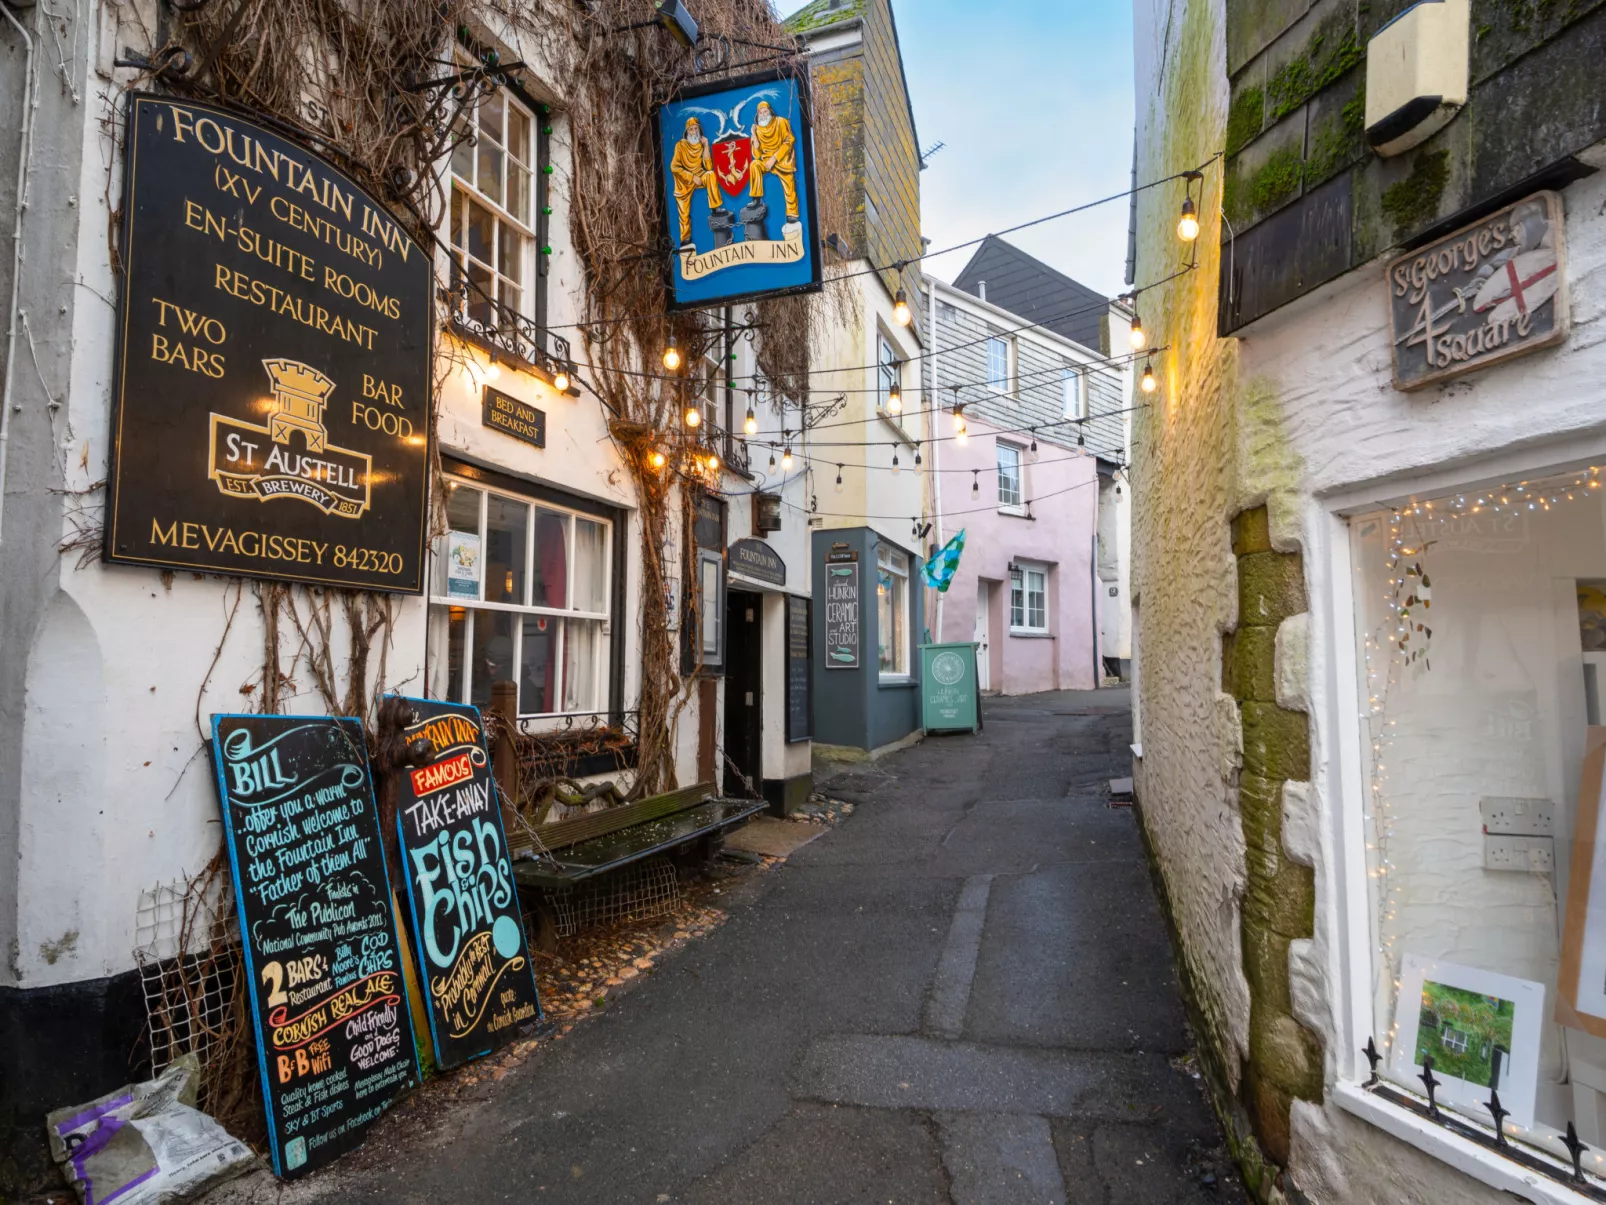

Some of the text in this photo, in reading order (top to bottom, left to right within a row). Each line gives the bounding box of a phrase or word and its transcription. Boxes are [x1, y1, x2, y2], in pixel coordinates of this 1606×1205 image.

[170, 105, 412, 263] FOUNTAIN INN
[214, 164, 383, 270] (XV CENTURY)
[185, 200, 401, 320] EN-SUITE ROOMS
[685, 242, 799, 276] FOUNTAIN INN
[152, 298, 226, 344] TWO
[214, 263, 379, 351] RESTAURANT
[1407, 291, 1455, 366] 4
[151, 334, 226, 379] BARS
[362, 373, 406, 410] BAR
[496, 396, 535, 423] BED AND
[352, 401, 413, 440] FOOD
[491, 409, 539, 440] BREAKFAST
[226, 433, 360, 490] ST AUSTELL
[261, 478, 330, 506] BREWERY
[337, 501, 359, 516] 1851
[149, 517, 403, 574] MEVAGISSEY 842320
[740, 547, 767, 566] FOUNTAIN
[767, 556, 777, 569] INN
[828, 585, 857, 600] HUNKIN
[827, 601, 858, 623] CERAMIC
[838, 621, 857, 633] ART
[828, 632, 857, 646] STUDIO
[228, 747, 299, 796] BILL
[414, 756, 469, 792] FAMOUS
[279, 799, 304, 827] you
[304, 793, 316, 809] a
[314, 783, 347, 806] warm
[404, 777, 490, 837] TAKE-AWAY
[245, 798, 365, 858] Cornish welcome to
[248, 823, 360, 882] the Fountain Inn
[305, 859, 321, 885] of
[320, 850, 352, 877] them
[409, 816, 500, 885] Fish
[284, 900, 357, 930] The Publican
[423, 857, 512, 969] Chips
[262, 933, 295, 956] National
[295, 927, 333, 948] Community
[332, 921, 347, 937] Pub
[346, 915, 369, 934] Awards
[361, 932, 389, 956] COD
[261, 960, 289, 1009] 2
[286, 953, 323, 989] BARS
[358, 949, 393, 979] CHIPS
[272, 974, 395, 1046] CORNISH REAL ALE
[288, 976, 333, 1007] Restaurant
[345, 1003, 398, 1041] Child Friendly
[452, 1011, 470, 1031] in
[308, 1037, 332, 1057] FREE
[349, 1029, 400, 1063] GOOD DOGS
[280, 1086, 308, 1106] Quality
[325, 1066, 348, 1087] cooked
[282, 1099, 305, 1118] Steak
[329, 1080, 350, 1097] dishes
[320, 1099, 344, 1117] Sports
[308, 1134, 329, 1152] Follow
[328, 1128, 338, 1140] us
[345, 1107, 375, 1130] Facebook
